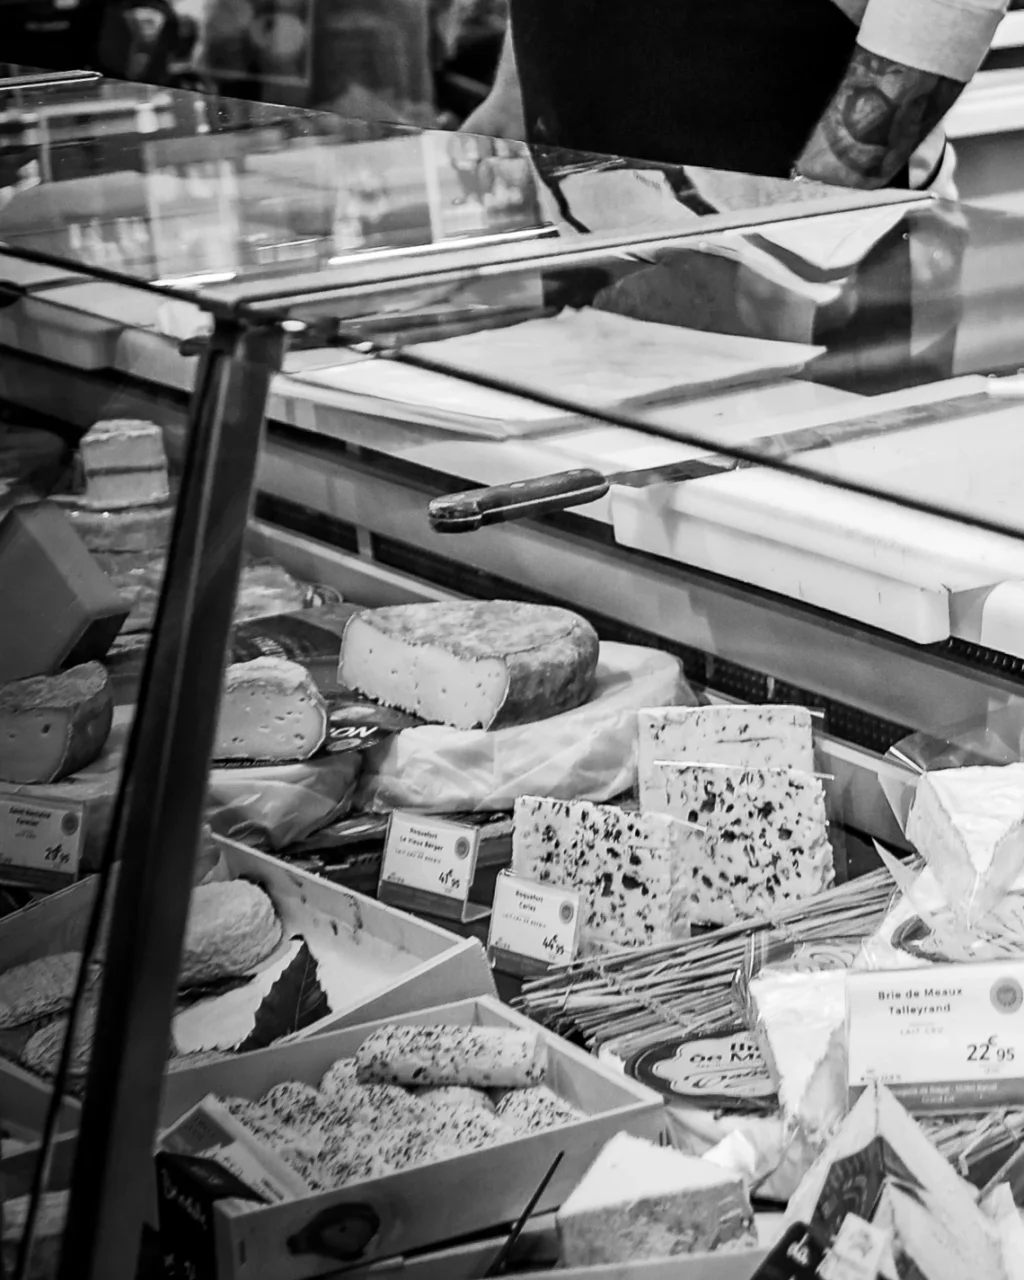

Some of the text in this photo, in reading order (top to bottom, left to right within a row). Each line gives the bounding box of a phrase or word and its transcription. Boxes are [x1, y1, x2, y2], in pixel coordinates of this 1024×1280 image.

[424, 841, 444, 852] Berger
[878, 987, 963, 1001] Brie de Meaux
[889, 1003, 951, 1016] Talleyrand
